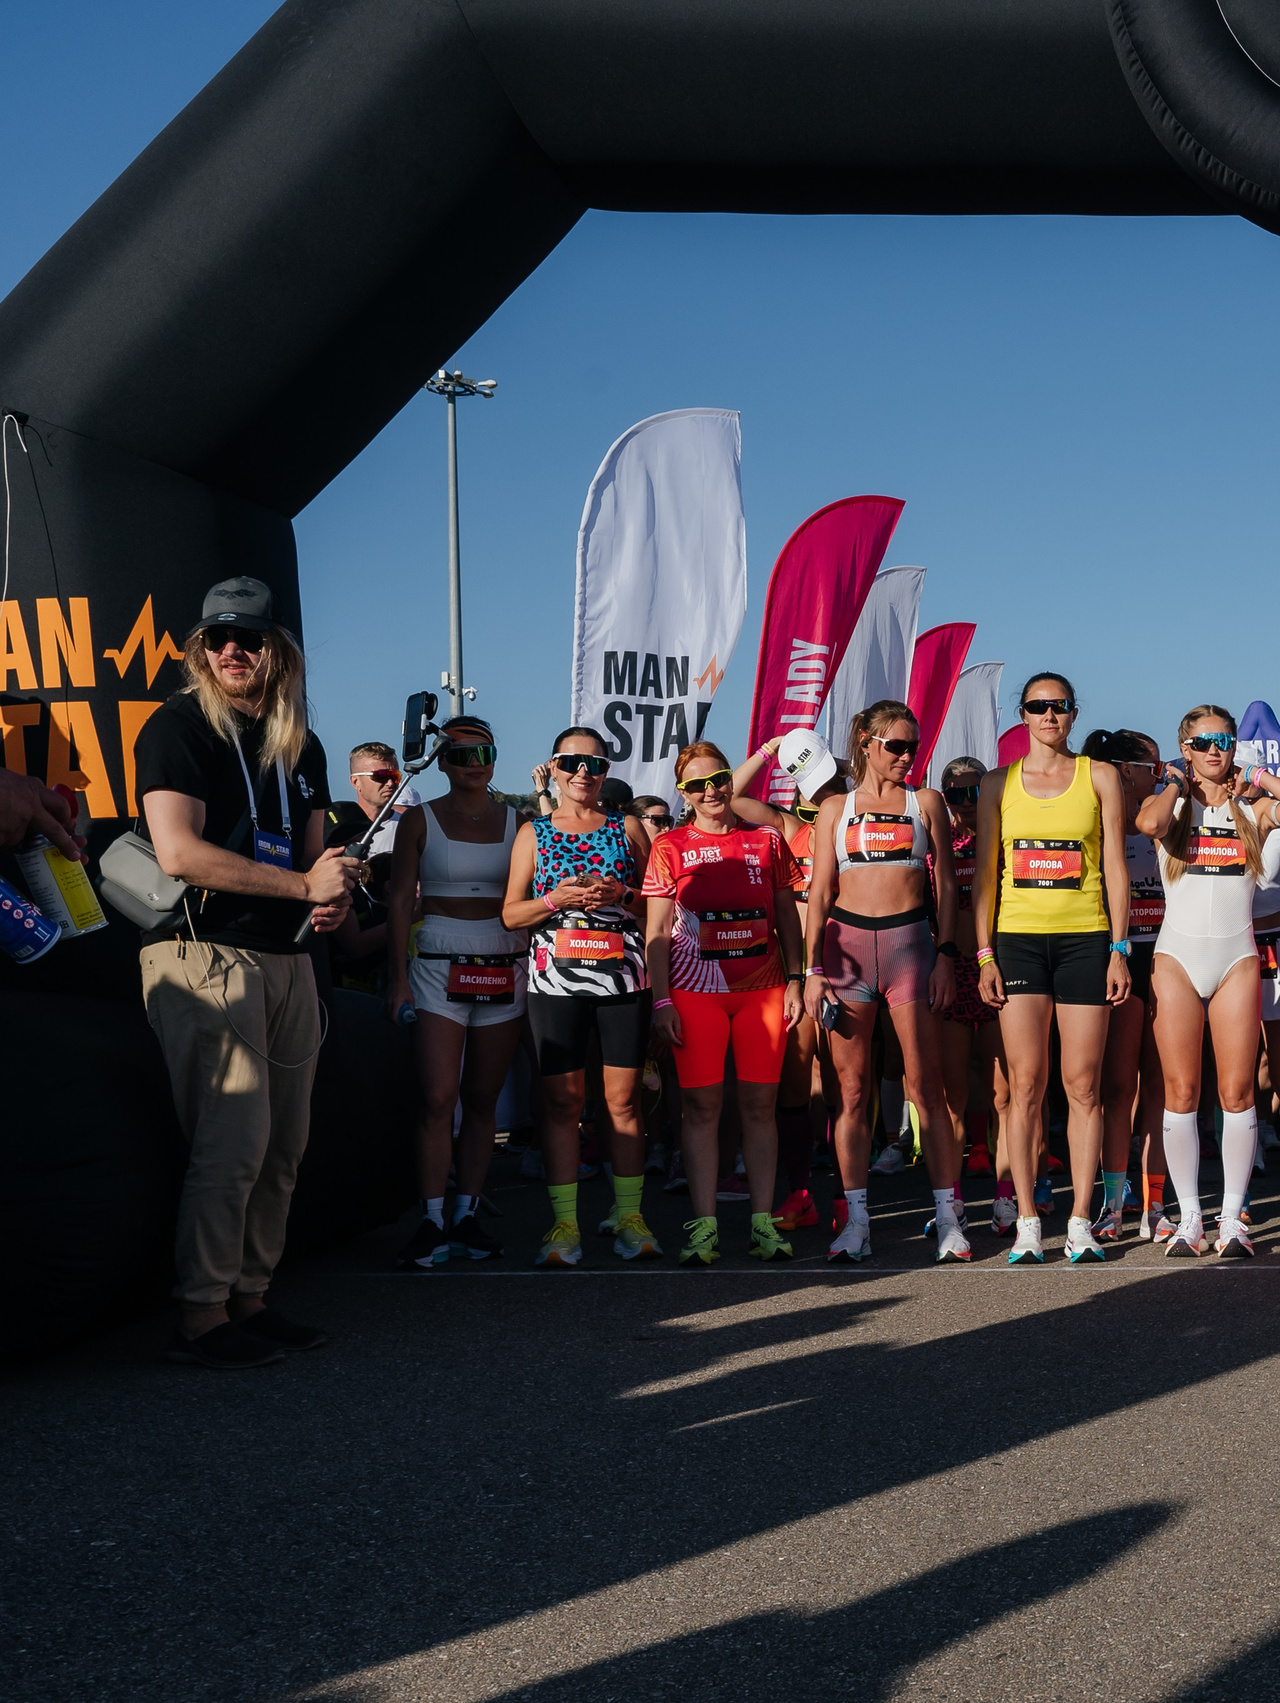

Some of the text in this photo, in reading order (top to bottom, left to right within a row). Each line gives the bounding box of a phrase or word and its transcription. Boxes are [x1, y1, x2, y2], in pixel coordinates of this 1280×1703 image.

[0, 597, 96, 691] AN
[603, 650, 690, 699] MAN
[780, 638, 830, 724] LADY
[0, 701, 165, 819] TA
[797, 748, 812, 763] STAR
[863, 832, 895, 841] ЕРНЫХ
[258, 839, 290, 855] IRON STAR
[1187, 846, 1238, 857] ПАНФИЛОВА
[682, 849, 697, 862] 10
[683, 856, 724, 869] SIRIUS SOCHI
[1029, 859, 1063, 869] ОРЛОВА
[1129, 908, 1165, 916] ХТОРОВИ
[717, 930, 753, 940] ГАЛЕЕВА
[569, 939, 610, 949] ХОХЛОВА
[460, 975, 507, 985] ВАСИЛЕНКО
